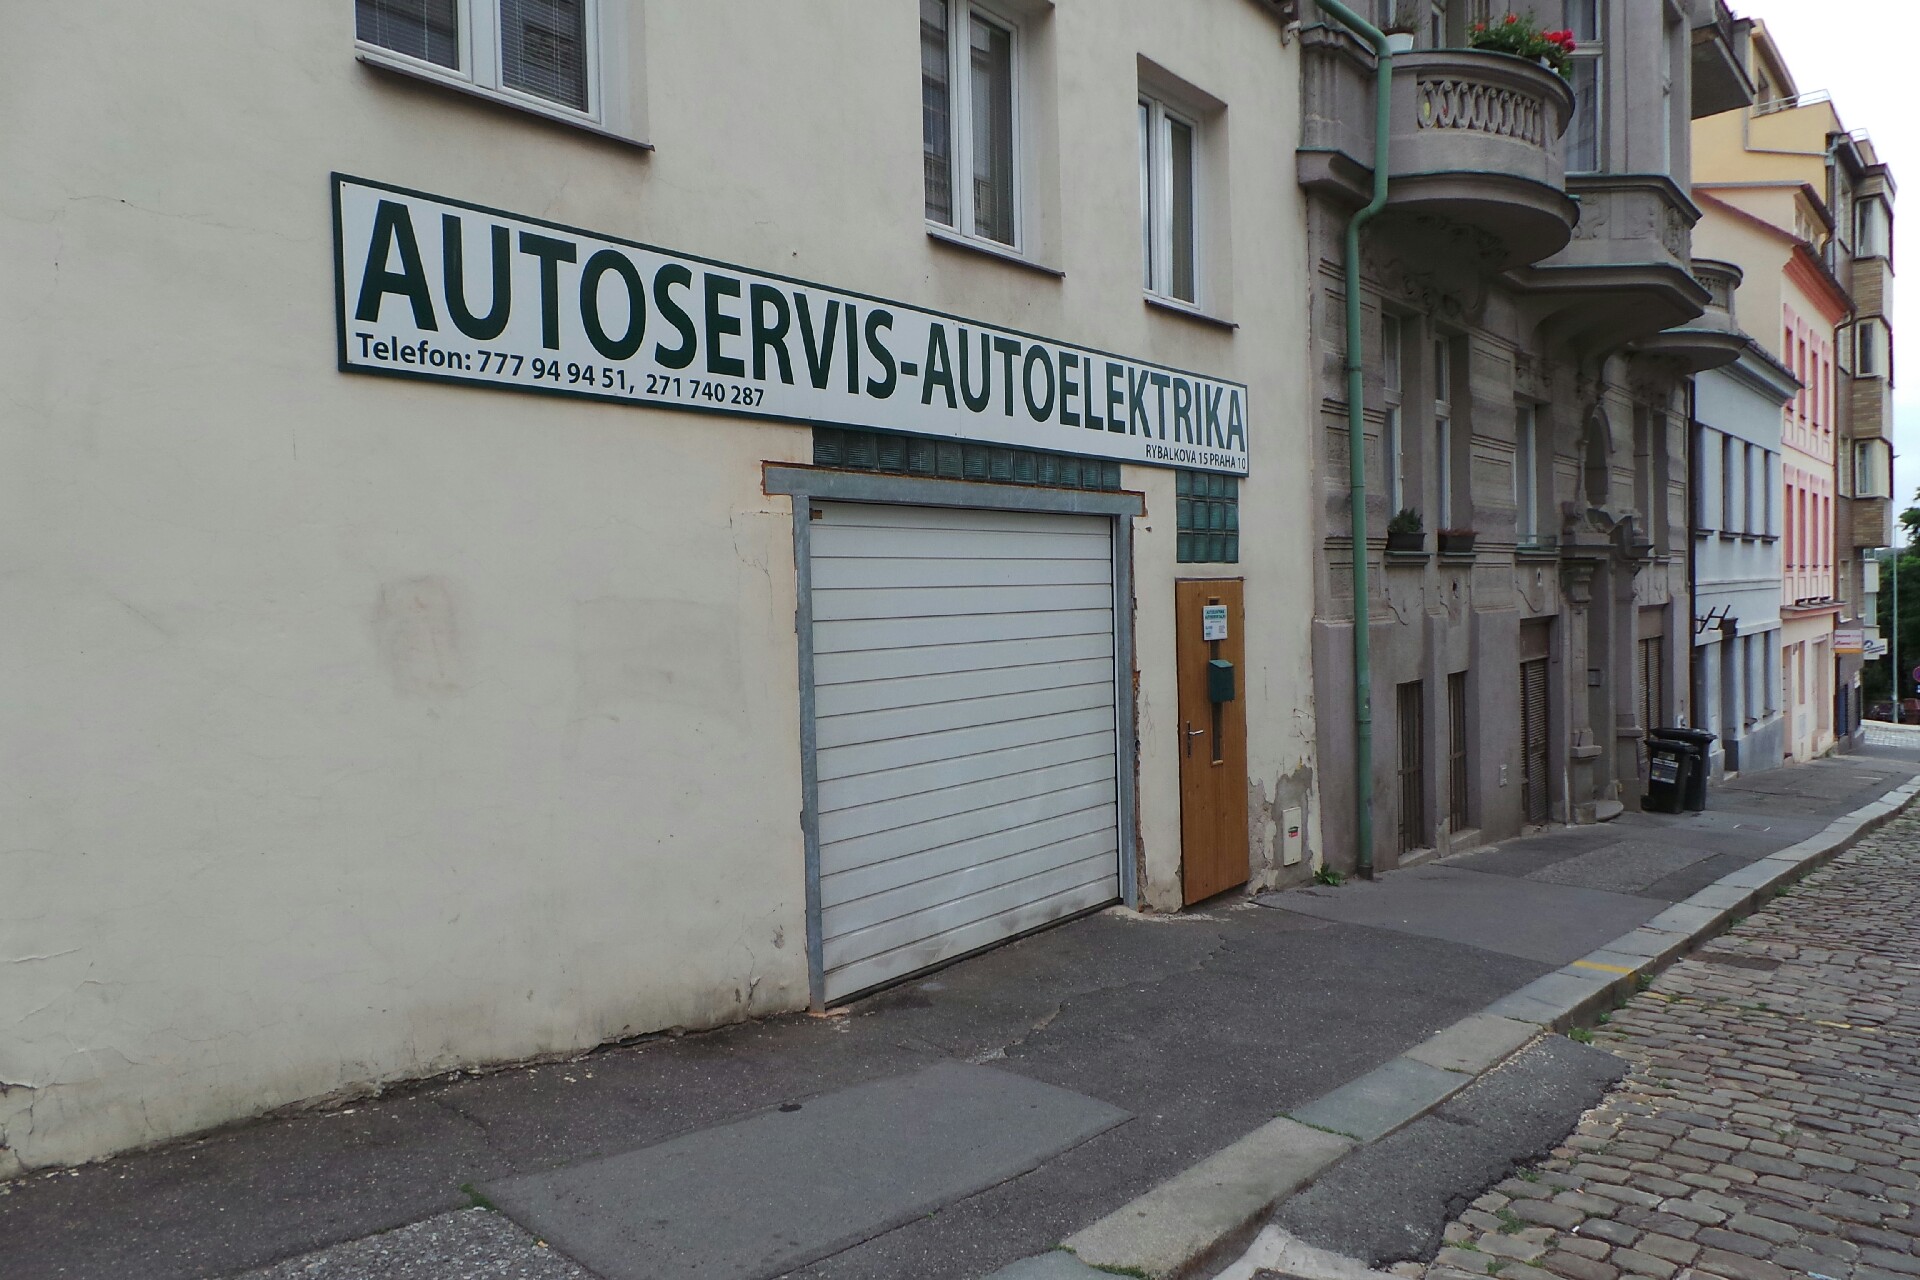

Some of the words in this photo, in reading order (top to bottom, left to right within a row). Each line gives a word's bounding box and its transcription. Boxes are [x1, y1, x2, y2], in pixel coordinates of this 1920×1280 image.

[354, 199, 1246, 453] AUTOSERVIS-AUTOELEKTRIKA
[355, 332, 471, 371] Telefon:
[477, 350, 524, 377] 777
[531, 357, 561, 382] 94
[567, 362, 595, 387] 94
[602, 367, 635, 394] 51,
[646, 373, 682, 397] 271
[689, 379, 726, 403] 740
[730, 385, 764, 407] 287
[1146, 444, 1197, 464] RYBALKOVA
[1198, 452, 1208, 465] 15
[1209, 453, 1236, 469] PRAHA
[1237, 457, 1246, 470] 10
